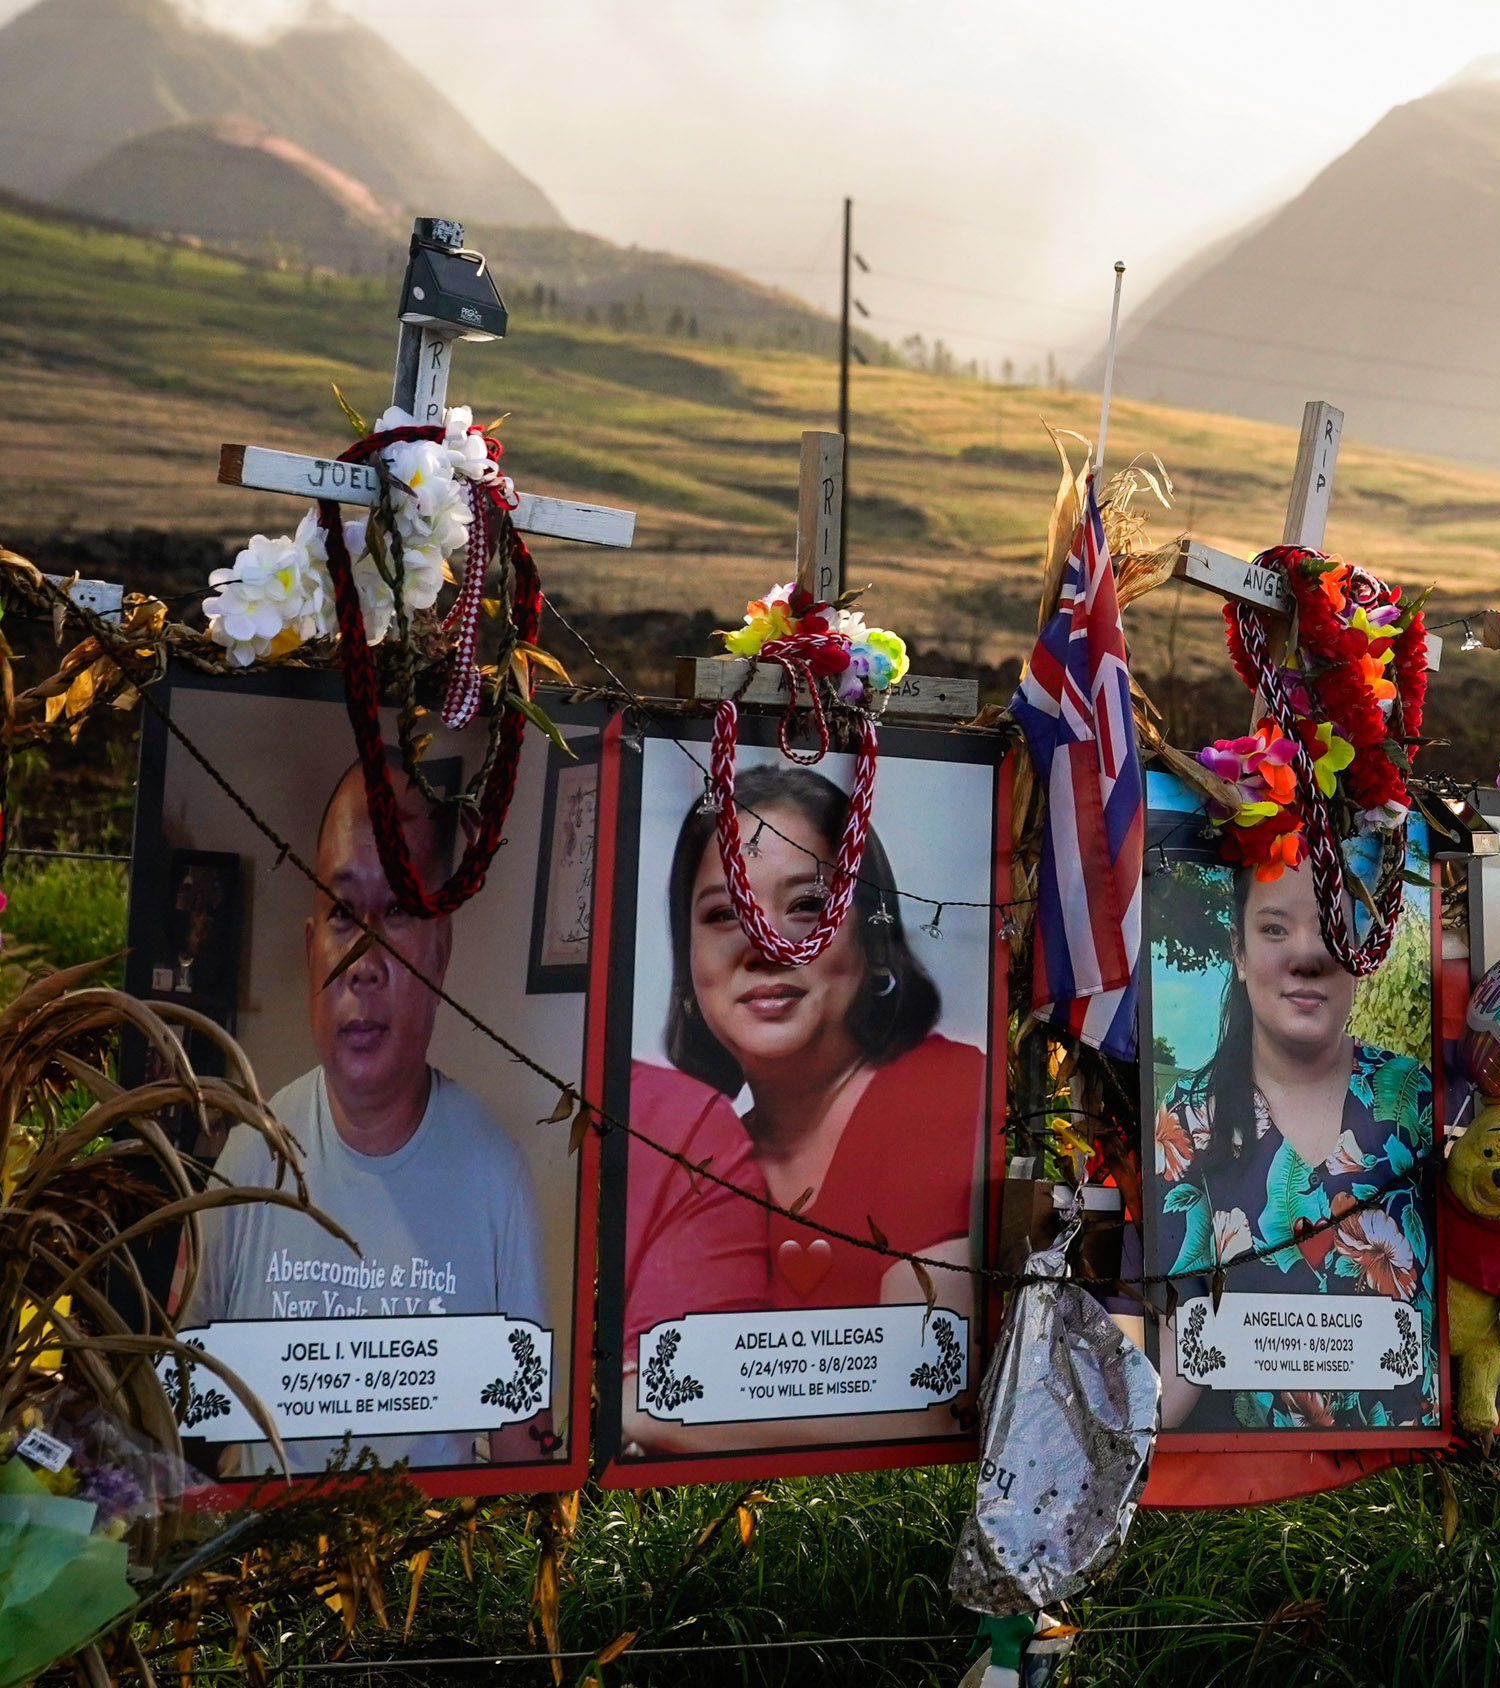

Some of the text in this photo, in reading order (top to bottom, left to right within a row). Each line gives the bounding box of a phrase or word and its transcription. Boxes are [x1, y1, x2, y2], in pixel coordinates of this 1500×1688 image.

[1316, 419, 1334, 493] RIP
[308, 460, 377, 492] JOEL
[819, 478, 834, 600] RIP
[265, 1249, 457, 1295] Abercrombie & Fitch
[1243, 1312, 1363, 1329] ANGELICA Q. BACLIG
[735, 1327, 884, 1350] ADELA Q. VILLEGAS
[1254, 1337, 1301, 1353] 11/11/1991
[1309, 1337, 1354, 1353] 8/8/2023
[281, 1339, 438, 1362] JOEL I. VILLEGAS
[740, 1359, 808, 1378] 6/24/1970
[819, 1356, 878, 1374] 8/8/2023
[1280, 1360, 1301, 1372] WILL
[1303, 1360, 1315, 1372] BE
[282, 1373, 351, 1393] 9/5/1967
[365, 1370, 436, 1389] 8/8/2023
[749, 1386, 774, 1399] YOU
[778, 1384, 805, 1397] WILL
[809, 1383, 824, 1396] BE
[319, 1400, 353, 1414] WILL
[356, 1399, 373, 1413] BE
